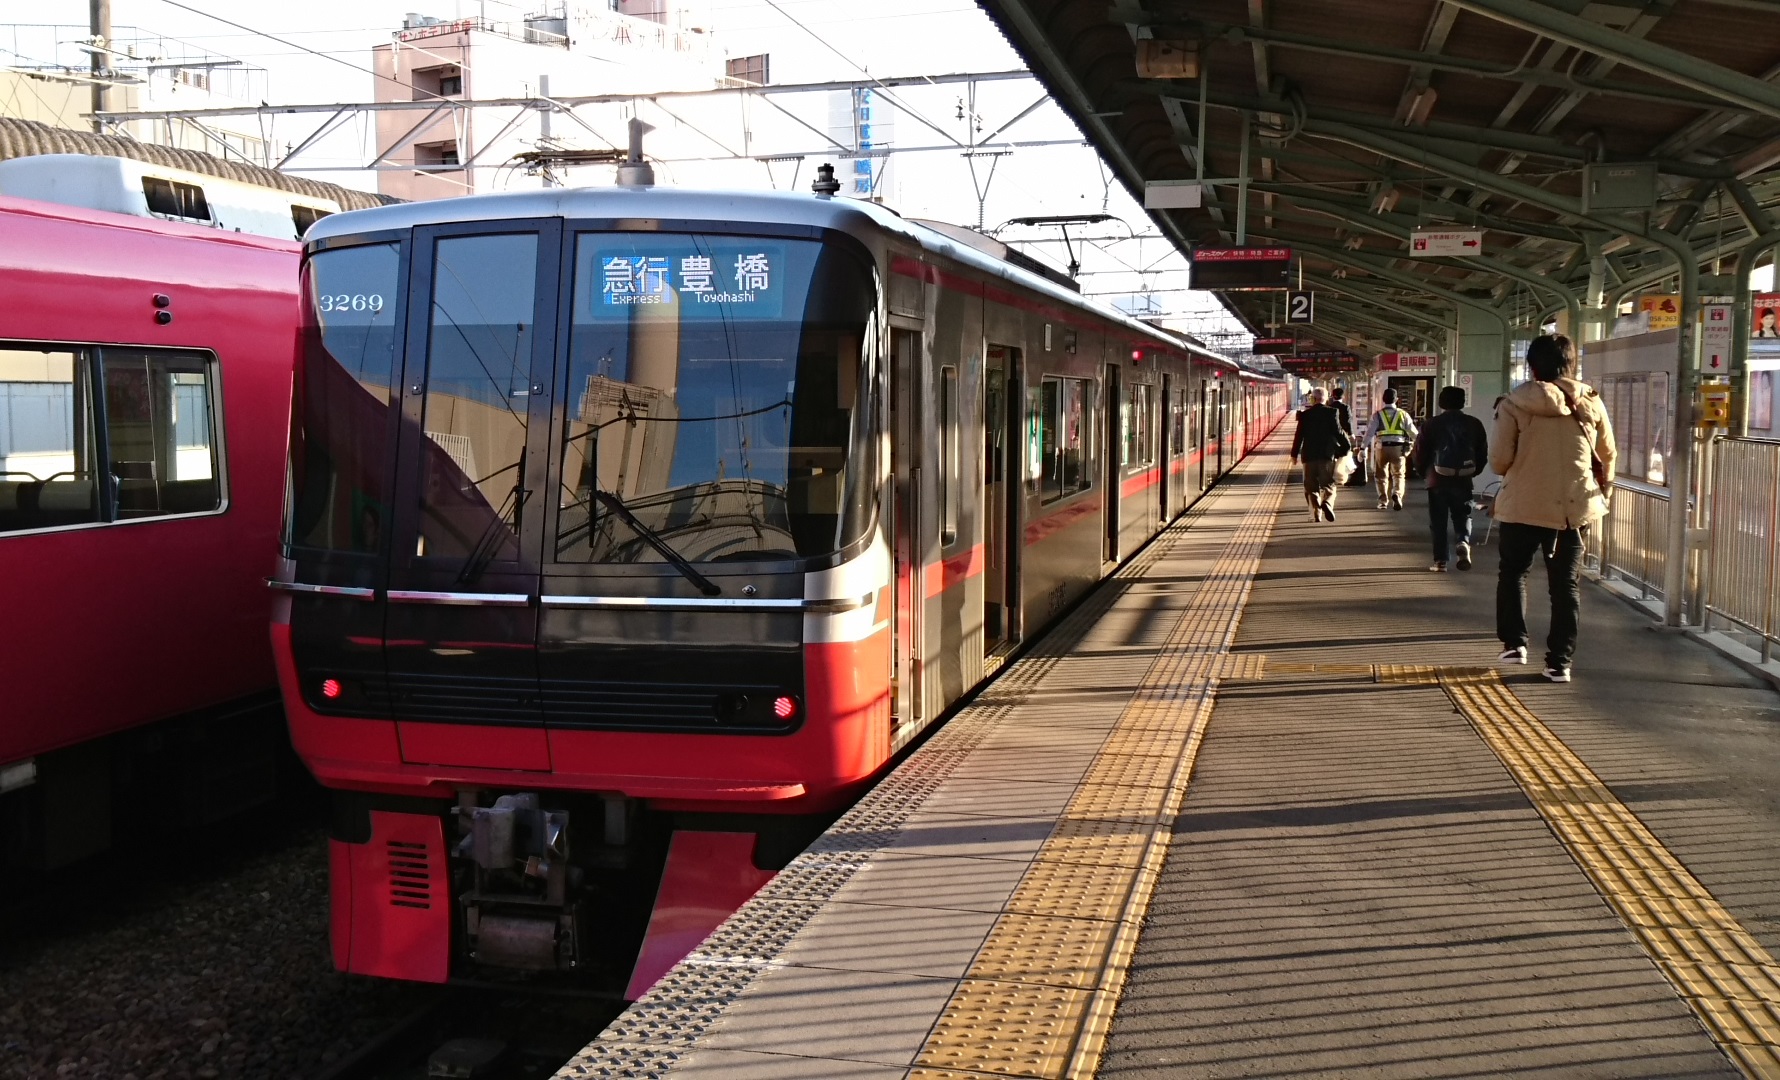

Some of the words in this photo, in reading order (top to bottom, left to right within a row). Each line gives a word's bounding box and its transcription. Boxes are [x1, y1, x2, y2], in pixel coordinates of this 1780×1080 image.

[603, 256, 668, 293] 急行
[679, 253, 769, 292] 豊橋
[320, 294, 383, 311] 3269
[611, 293, 661, 304] Express
[695, 291, 755, 304] Toyohashi
[1291, 295, 1308, 318] 2
[1400, 356, 1436, 367] 自販機コ
